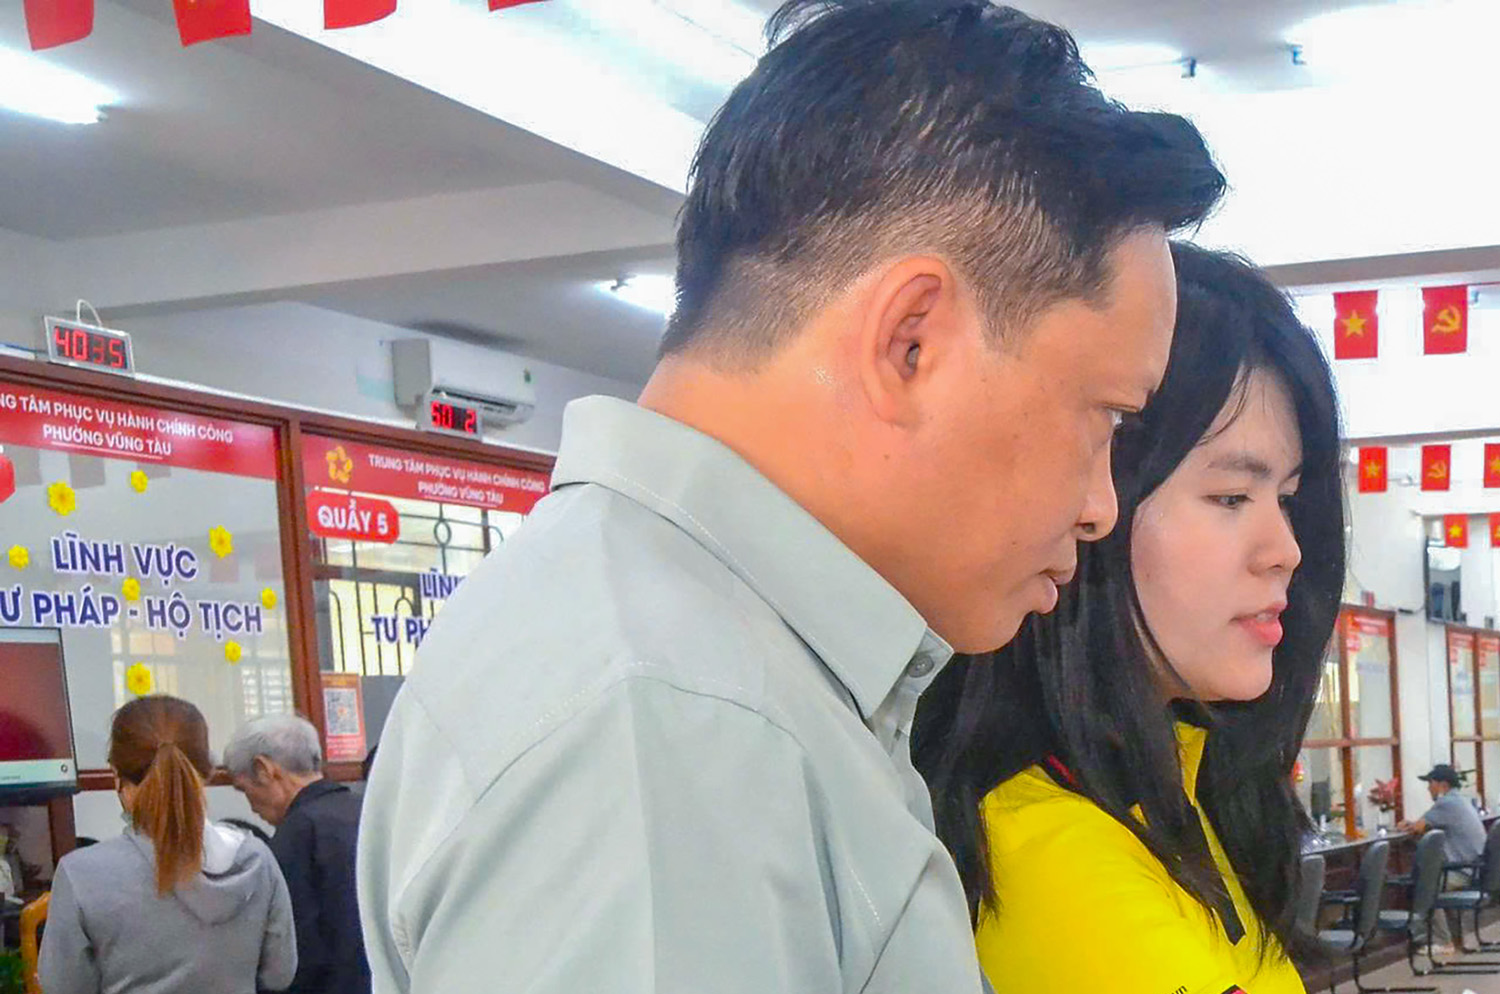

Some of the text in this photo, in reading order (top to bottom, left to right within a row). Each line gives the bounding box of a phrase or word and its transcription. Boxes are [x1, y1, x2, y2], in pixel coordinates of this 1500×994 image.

[18, 394, 51, 415] TÂM
[53, 402, 93, 423] PHỤC
[96, 409, 115, 428] VỤ
[117, 411, 154, 431] HÀNH
[156, 417, 196, 438] CHÍNH
[198, 423, 234, 443] CÔNG
[43, 424, 172, 456] PHƯỜNG VŨNG TÀU
[376, 513, 389, 535] 5
[52, 531, 197, 585] LĨNH VỰC
[33, 586, 119, 625] PHÁP
[146, 592, 191, 638] HỘ
[199, 602, 263, 639] TỊCH
